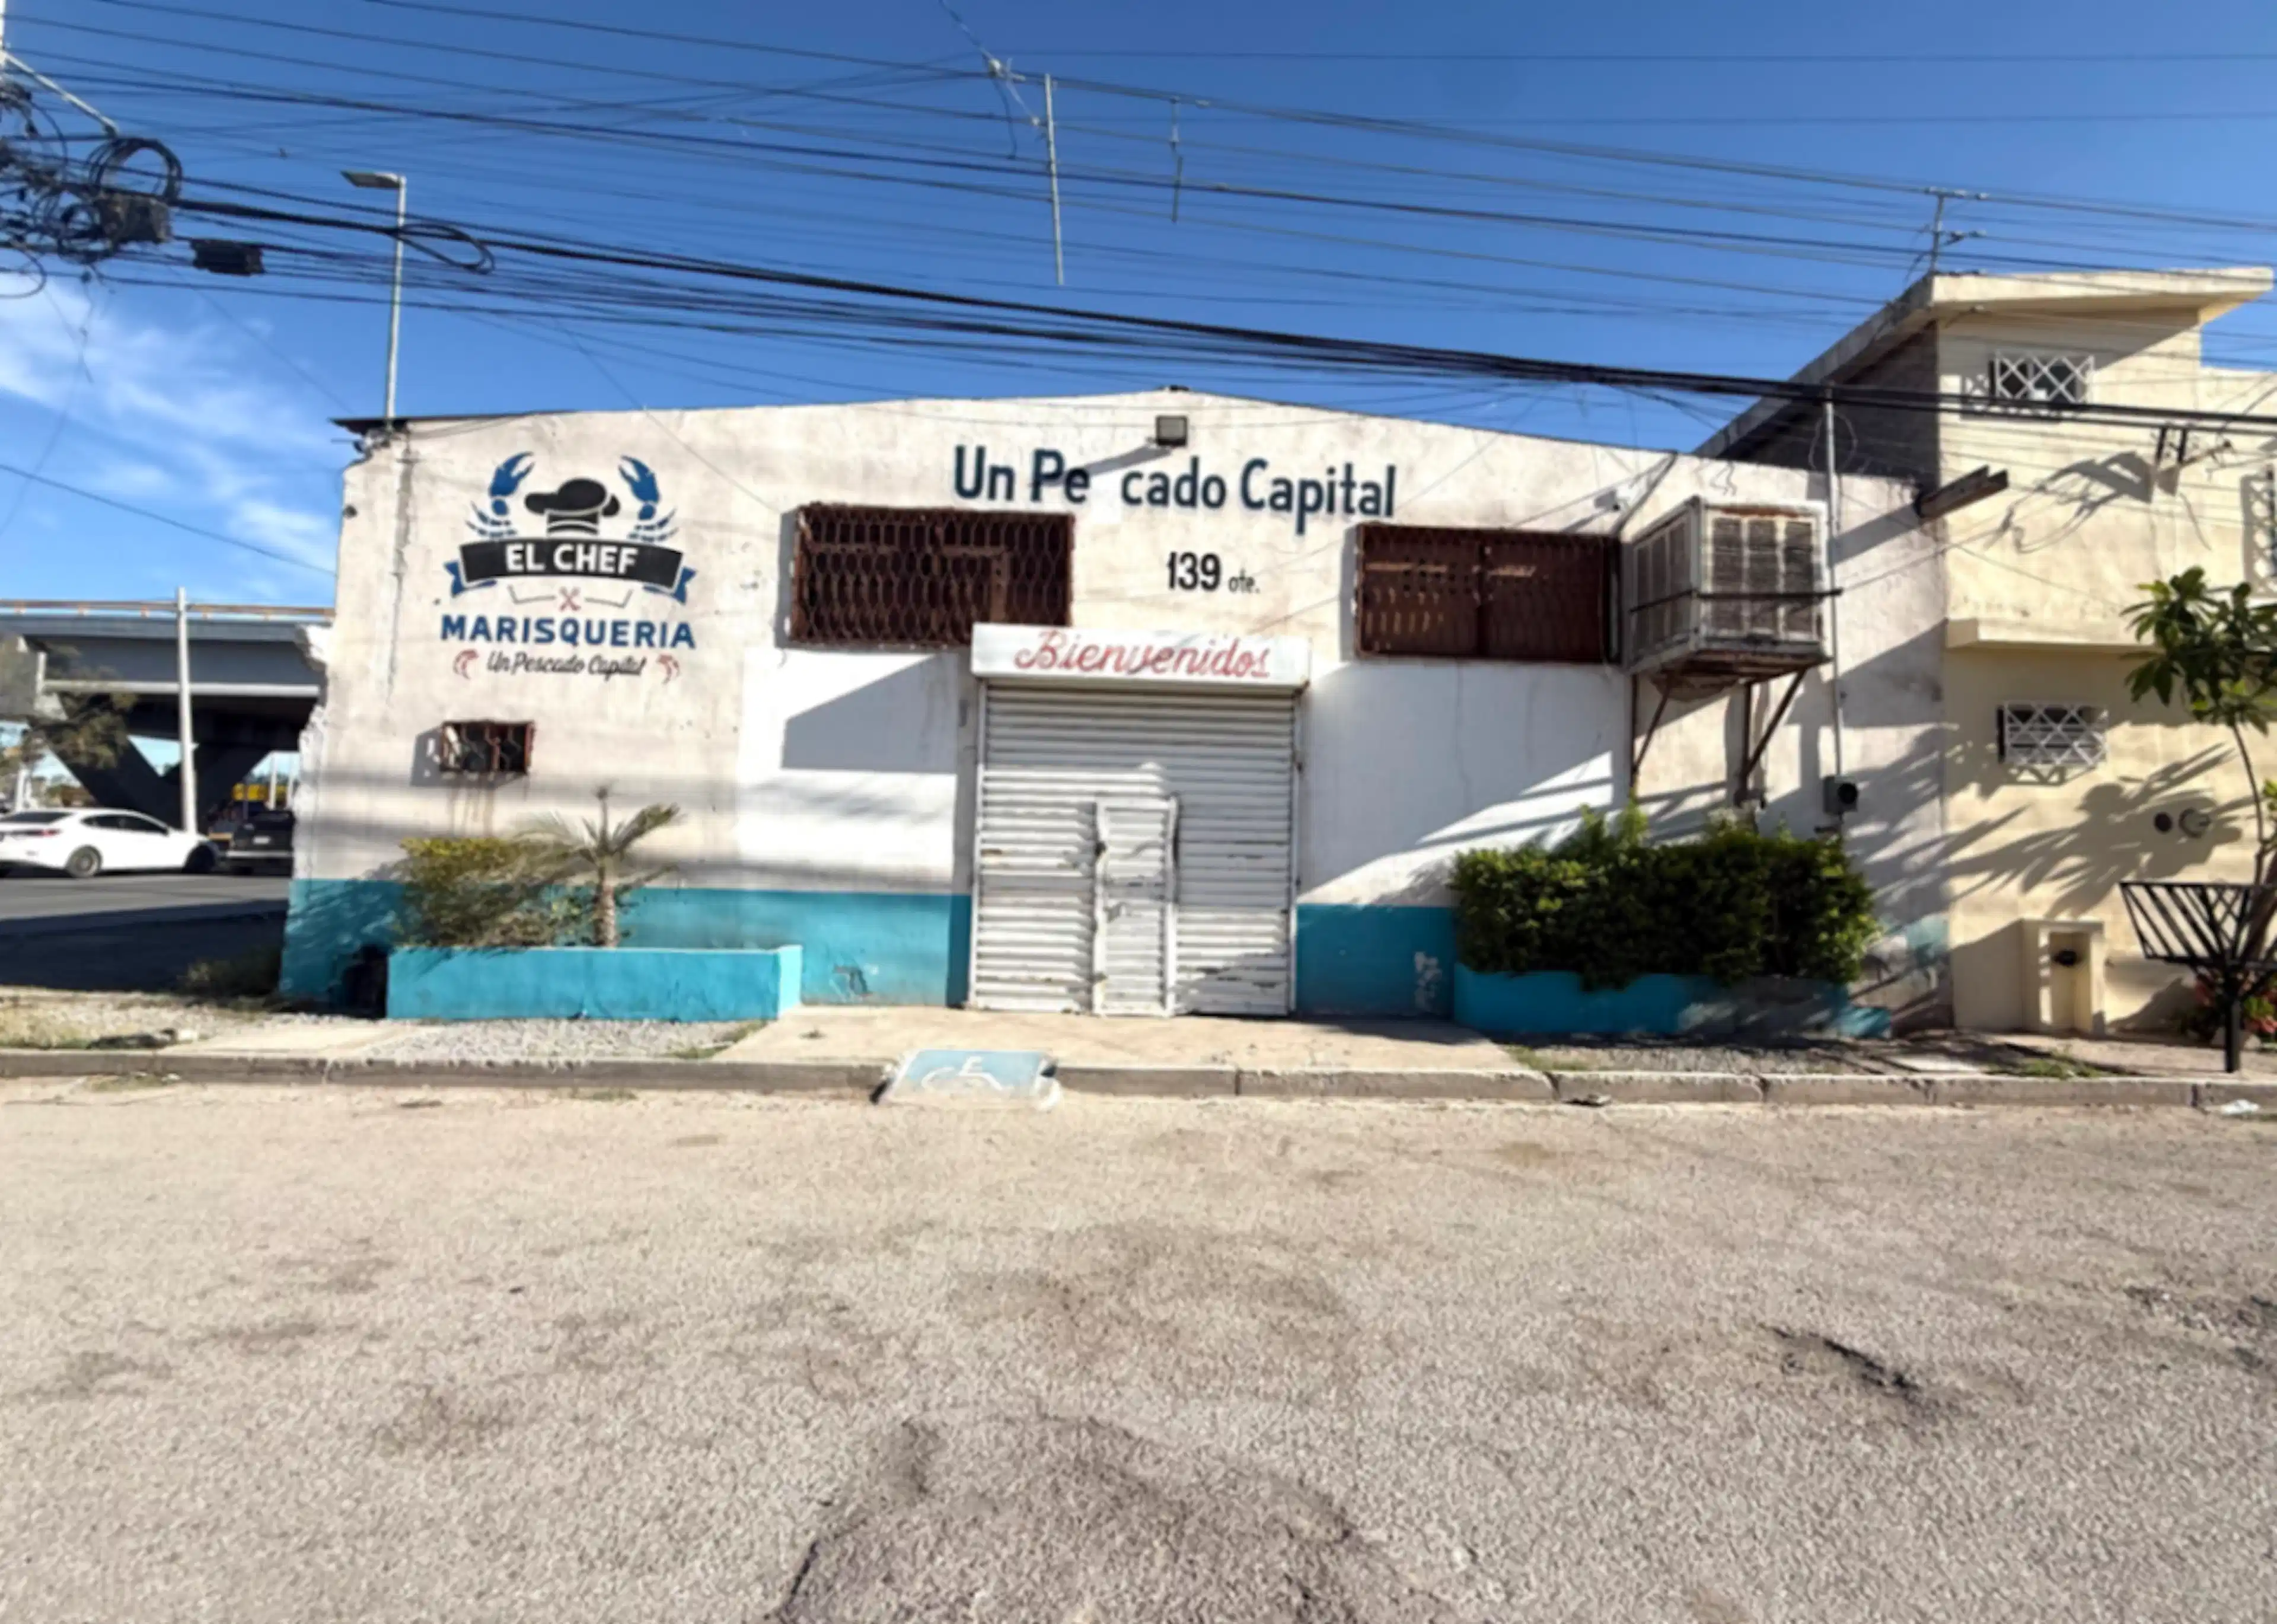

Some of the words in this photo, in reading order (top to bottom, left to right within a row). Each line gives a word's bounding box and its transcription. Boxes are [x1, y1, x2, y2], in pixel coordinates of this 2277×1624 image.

[953, 445, 1015, 501] Un
[1240, 459, 1397, 535] Capital
[505, 543, 545, 572] EL
[553, 544, 639, 575] CHEF
[1167, 551, 1222, 592] 139
[441, 614, 696, 650] MARISQUERIA
[487, 650, 509, 672] Un
[510, 651, 585, 675] Pescado
[588, 653, 647, 681] Capital
[1013, 630, 1271, 678] Bienvenidos
